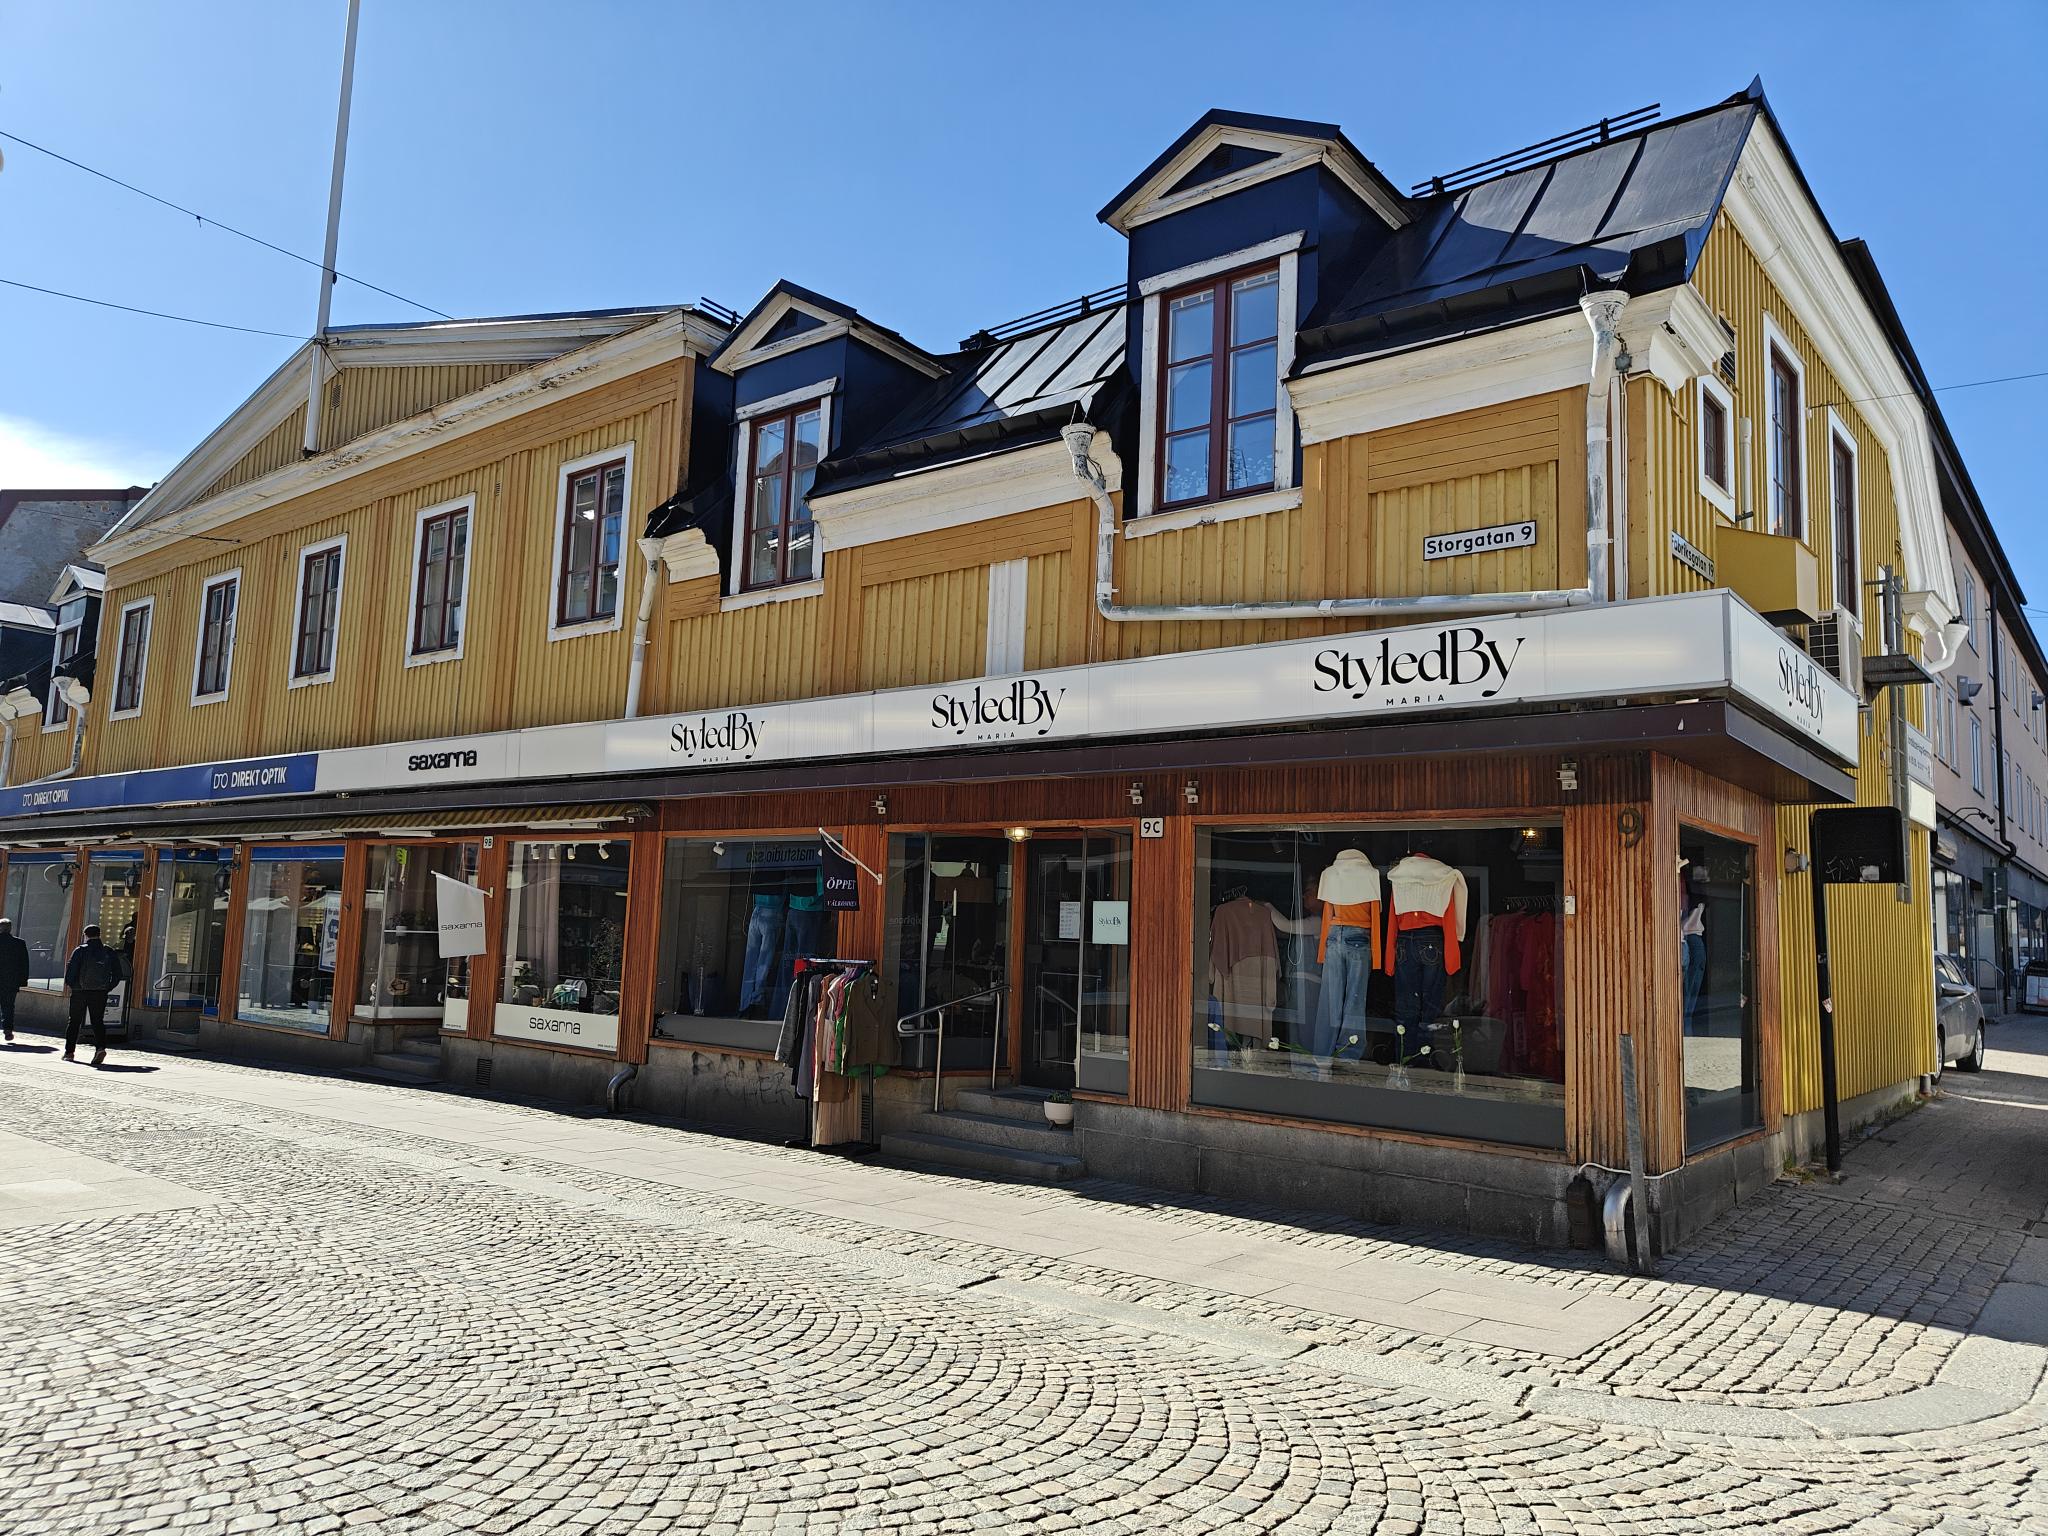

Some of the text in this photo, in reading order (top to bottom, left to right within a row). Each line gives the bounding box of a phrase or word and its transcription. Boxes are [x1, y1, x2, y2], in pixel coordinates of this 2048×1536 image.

[1427, 526, 1532, 553] Storgatan 9
[1314, 628, 1526, 699] StyledBy
[1386, 694, 1445, 706] MARIA
[1779, 647, 1826, 735] StyledBy
[932, 679, 1066, 735] StyledBy
[671, 712, 765, 759] StyledBy
[977, 732, 1015, 741] MARIA
[408, 750, 477, 771] saxarna
[231, 769, 260, 788] DIREKT
[261, 766, 287, 785] OPTIK
[34, 791, 52, 805] DIREKT
[52, 789, 69, 803] OPTIK
[1143, 821, 1161, 833] 9C
[1618, 807, 1643, 848] 9
[826, 876, 856, 890] ÖPPET
[441, 921, 483, 931] saxarna
[529, 1017, 581, 1035] saxarna
